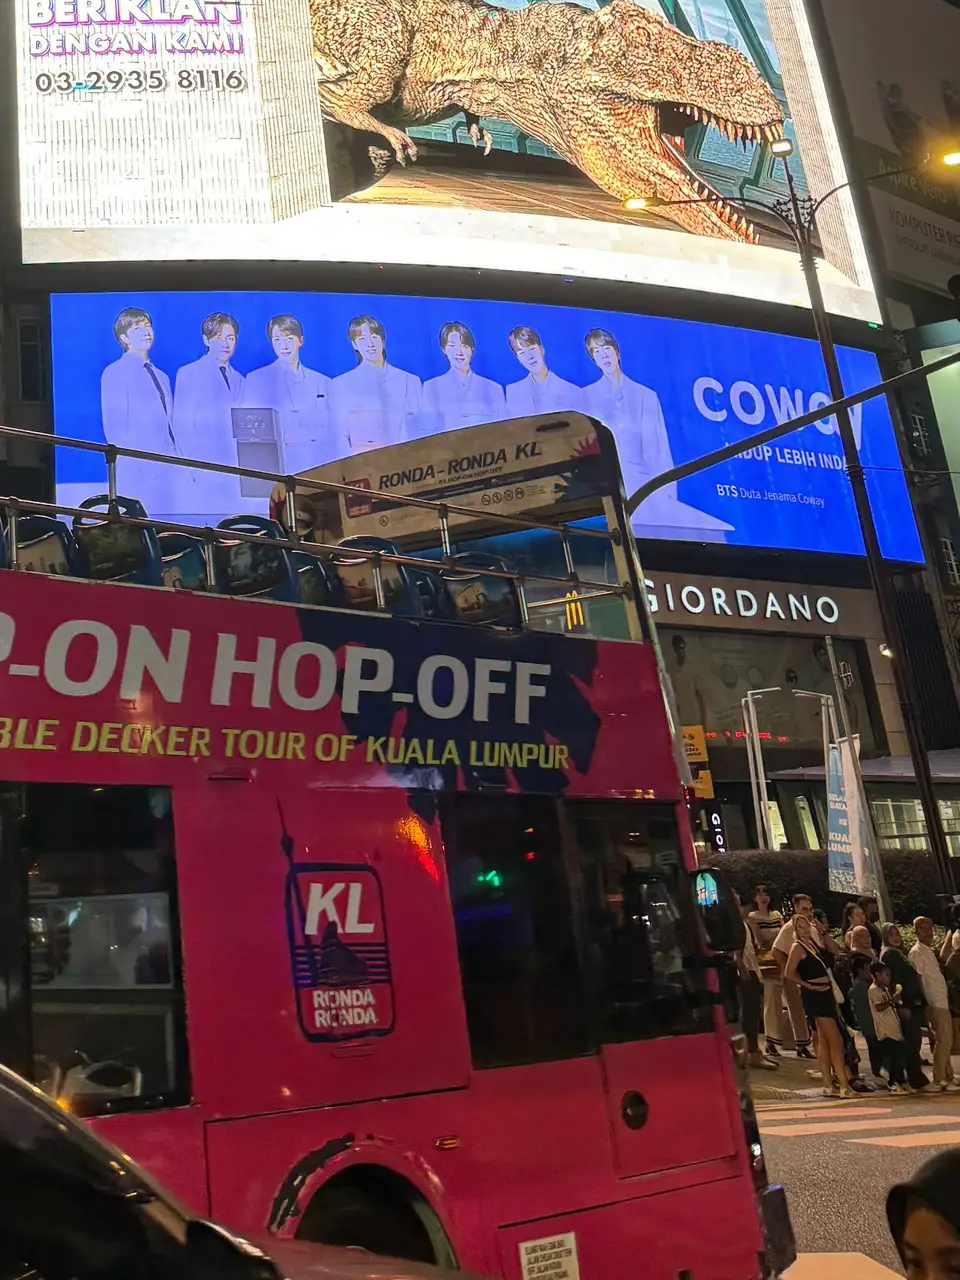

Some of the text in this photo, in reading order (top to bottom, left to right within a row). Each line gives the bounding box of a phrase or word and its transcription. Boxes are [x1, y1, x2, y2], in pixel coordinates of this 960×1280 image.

[30, 30, 245, 57] DENGAN KAMI
[35, 68, 243, 93] 03-2935 8116
[514, 441, 542, 461] KL
[775, 447, 817, 467] LEBIH
[716, 483, 825, 509] BTS Duta Jenama Coway
[209, 631, 552, 725] HOP-OFF
[71, 720, 211, 758] DECKER
[220, 727, 306, 761] TOUR
[314, 733, 357, 763] OF
[365, 735, 461, 766] KUALA
[469, 740, 570, 771] LUMPUR
[829, 793, 848, 802] SELA
[830, 802, 848, 812] DATA
[828, 832, 852, 844] KUA
[304, 882, 375, 935] KL
[313, 988, 376, 1009] RONDA
[314, 1007, 378, 1028] RONDA
